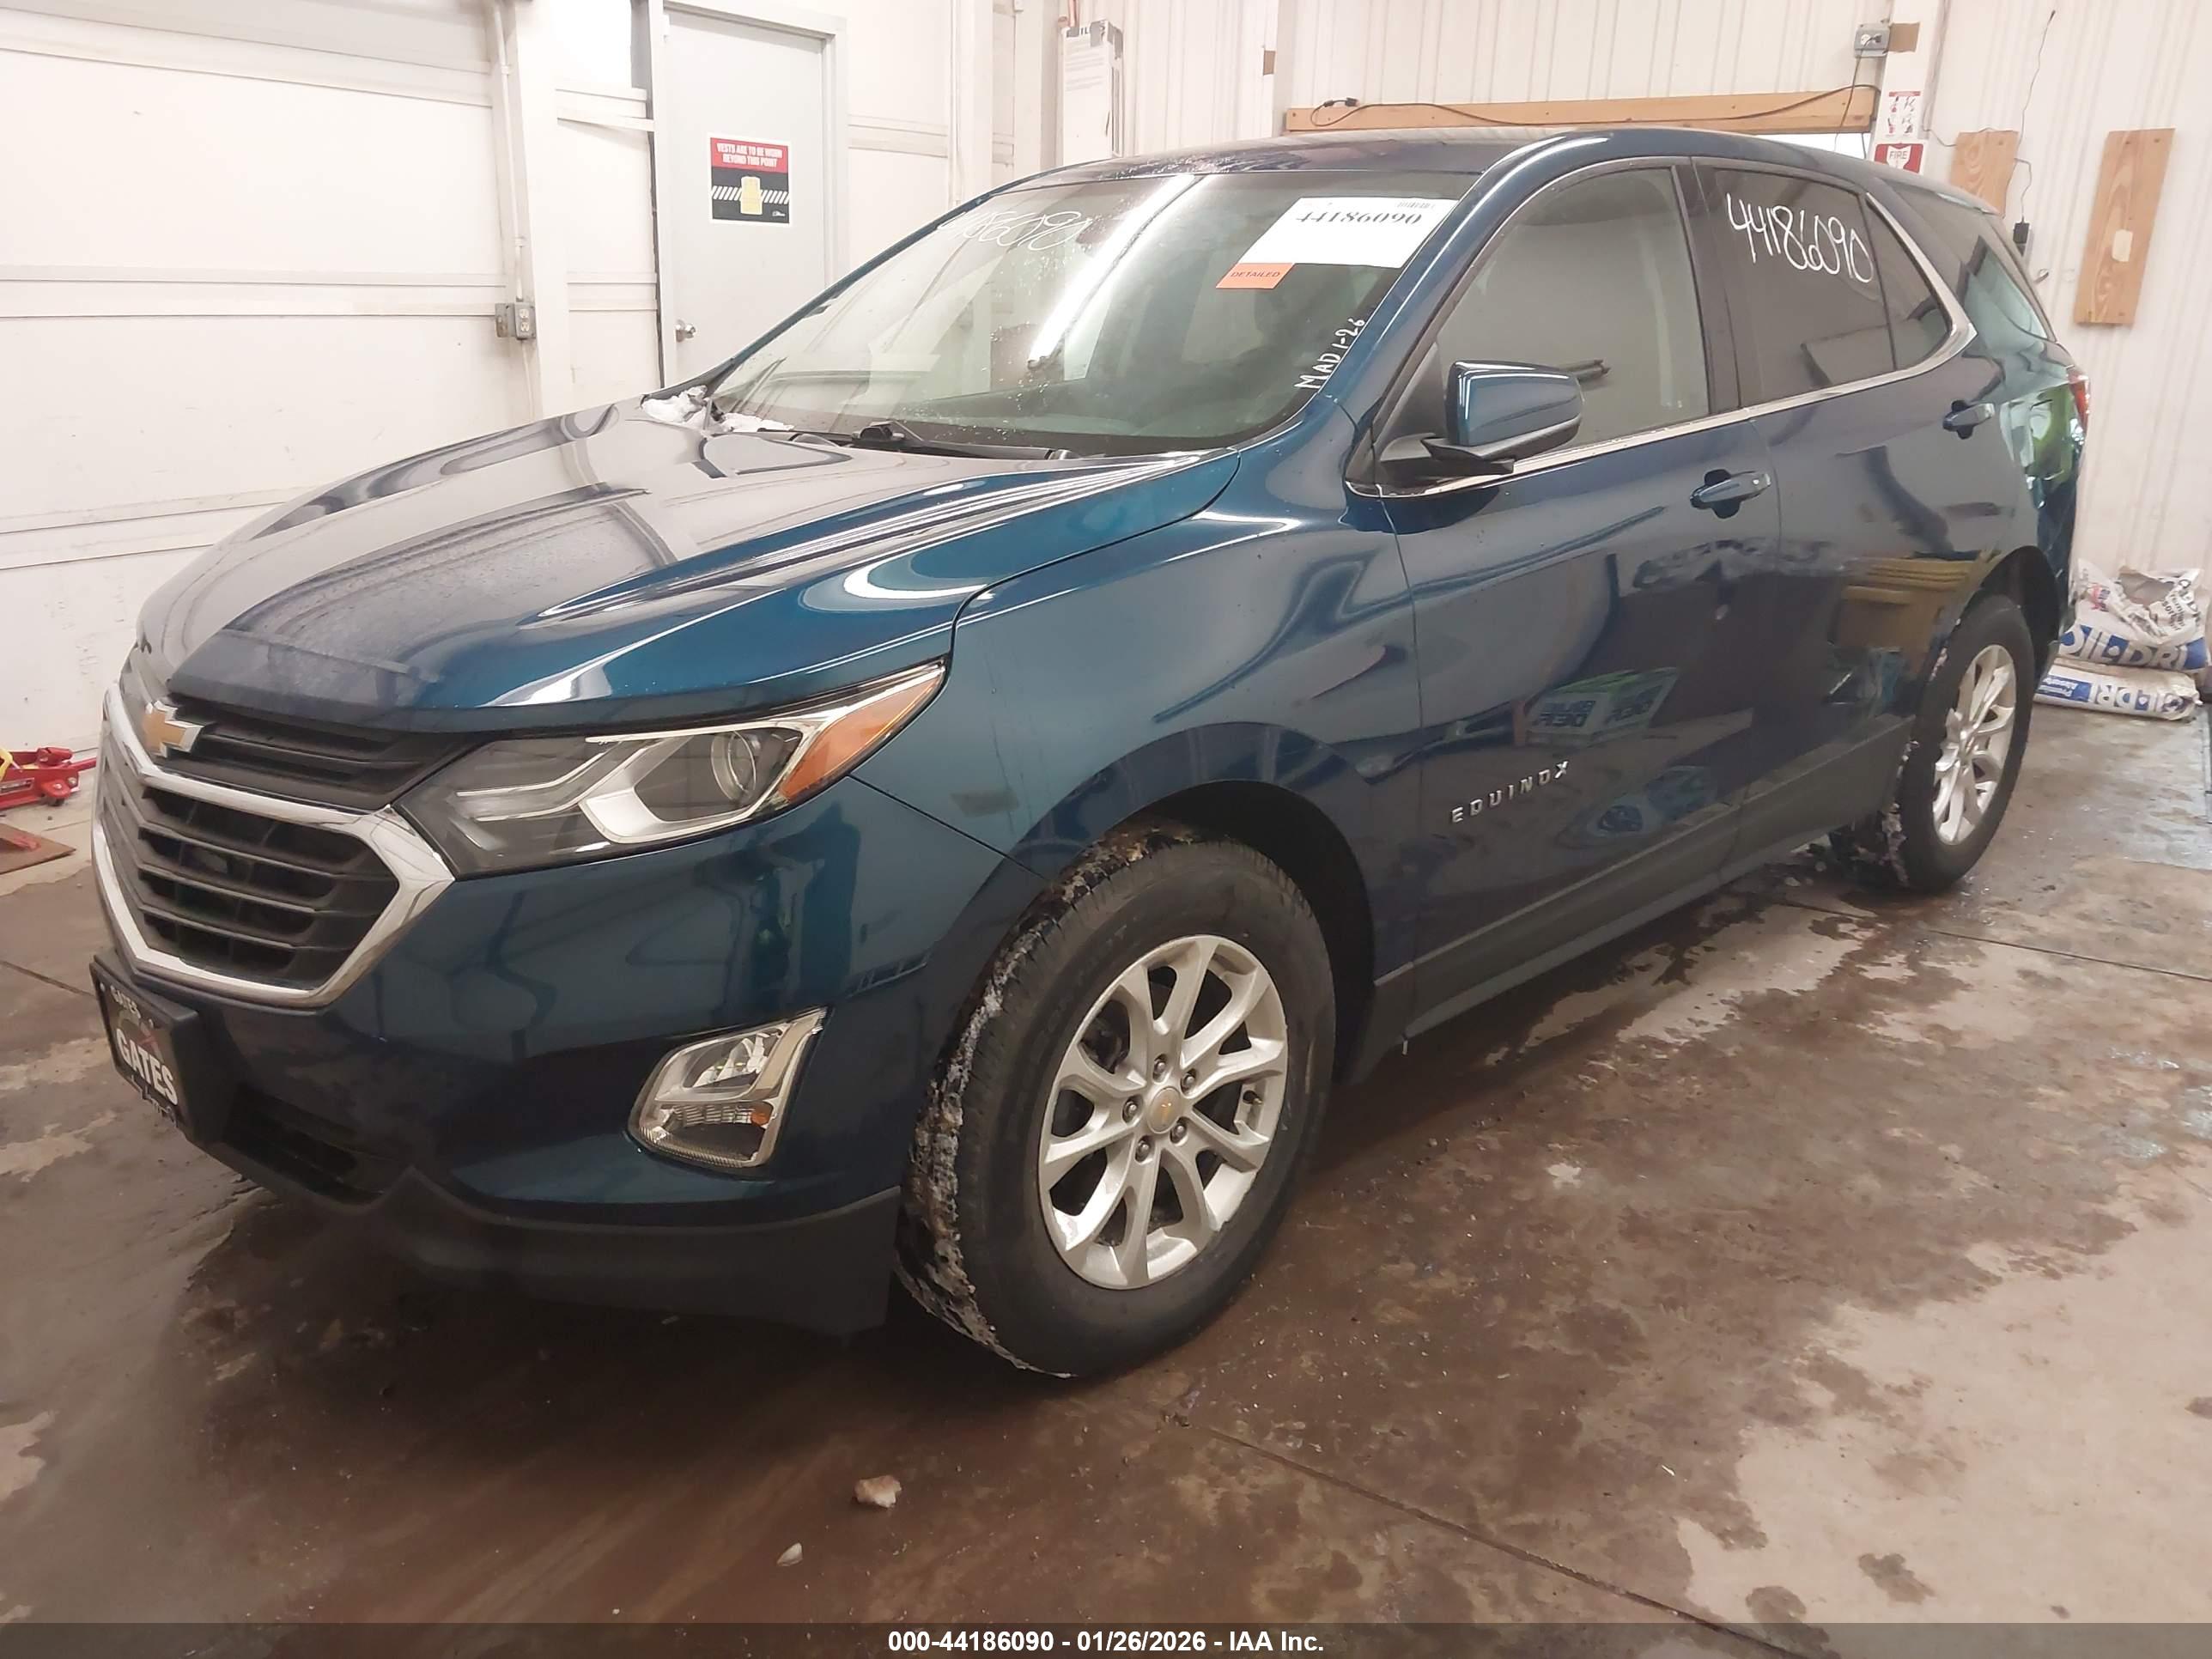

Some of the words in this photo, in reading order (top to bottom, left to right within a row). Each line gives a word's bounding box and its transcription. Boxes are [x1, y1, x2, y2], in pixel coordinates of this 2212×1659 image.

[716, 143, 735, 153] VESTS
[736, 144, 748, 155] ARE
[748, 146, 756, 156] TO
[757, 147, 764, 156] BE
[1888, 150, 1909, 161] FIRE
[722, 153, 746, 164] BEYOND
[747, 155, 759, 165] THIS
[760, 156, 777, 167] POINT
[1296, 211, 1423, 226] 44186090
[1726, 191, 1875, 283] 44186090
[1230, 270, 1282, 279] DETAILED
[1293, 350, 1343, 390] MAD
[1451, 760, 1570, 823] EQUINOX
[116, 1028, 179, 1106] GATES
